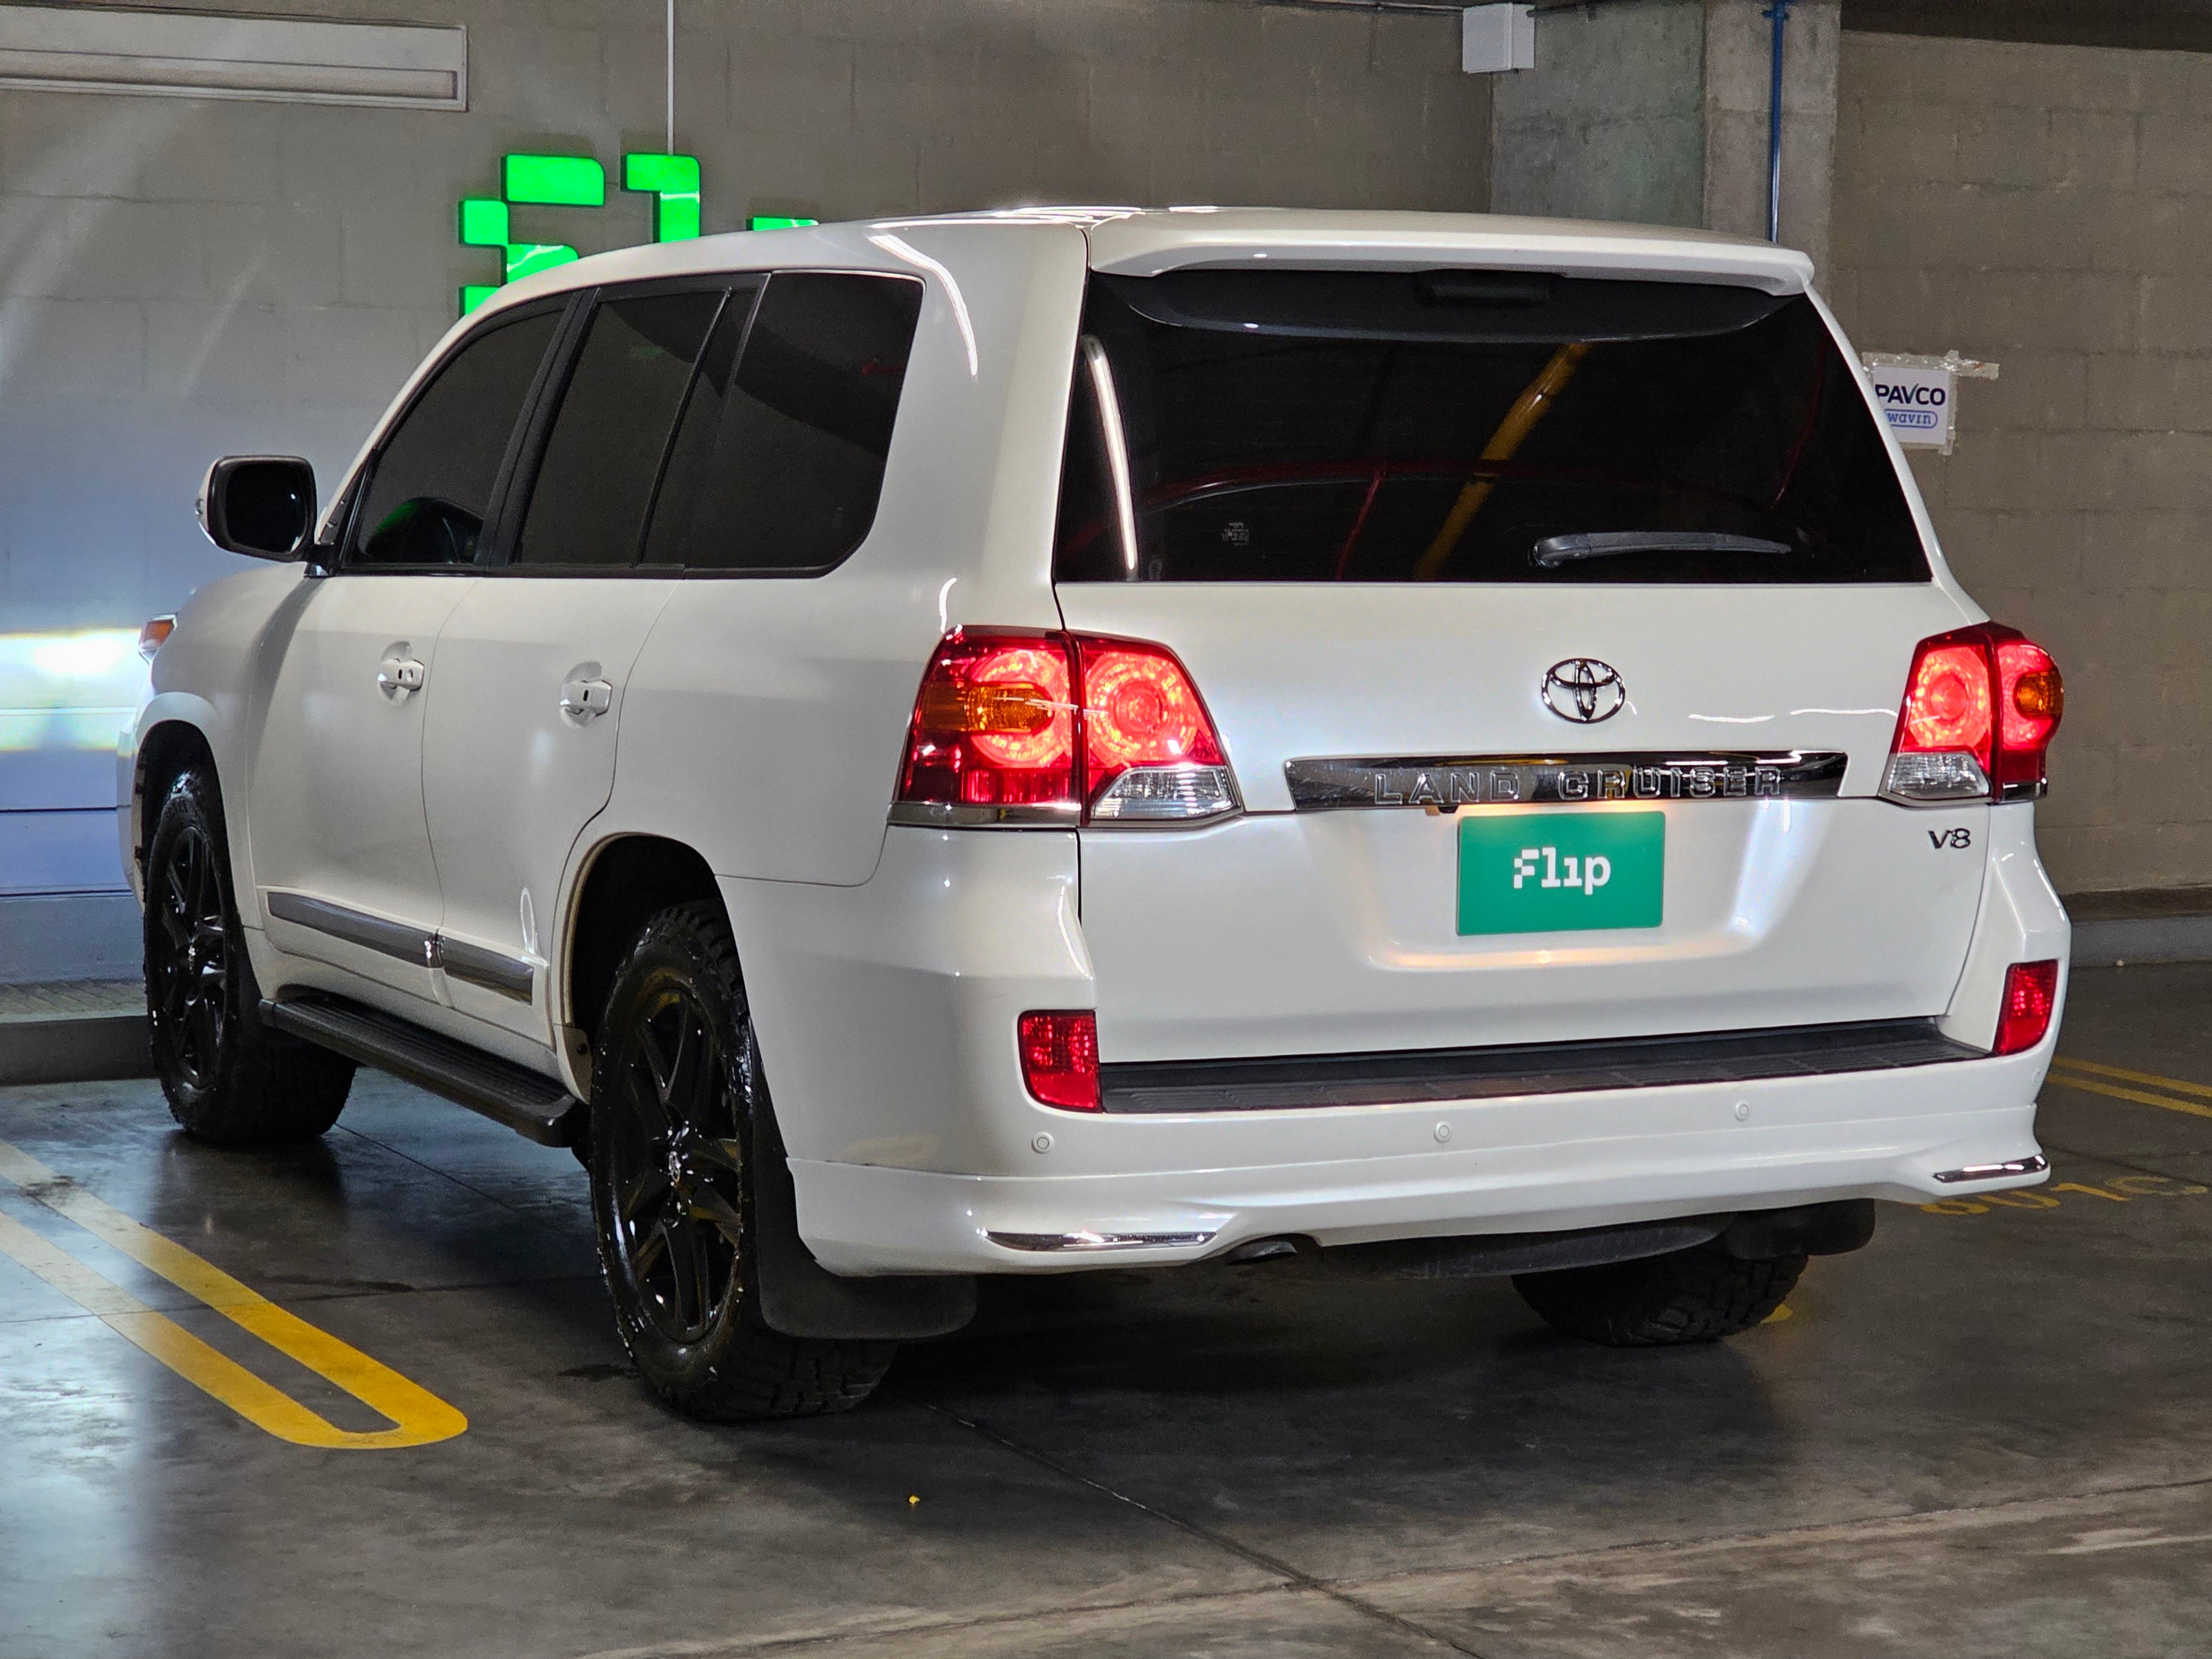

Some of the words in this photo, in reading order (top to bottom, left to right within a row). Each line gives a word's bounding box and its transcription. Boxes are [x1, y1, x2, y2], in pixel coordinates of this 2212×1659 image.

[1875, 383, 1946, 405] PAVCO
[1886, 413, 1931, 425] wavin
[1375, 772, 1520, 805] LAND
[1558, 765, 1781, 801] CRUISER
[1927, 828, 1971, 849] V8
